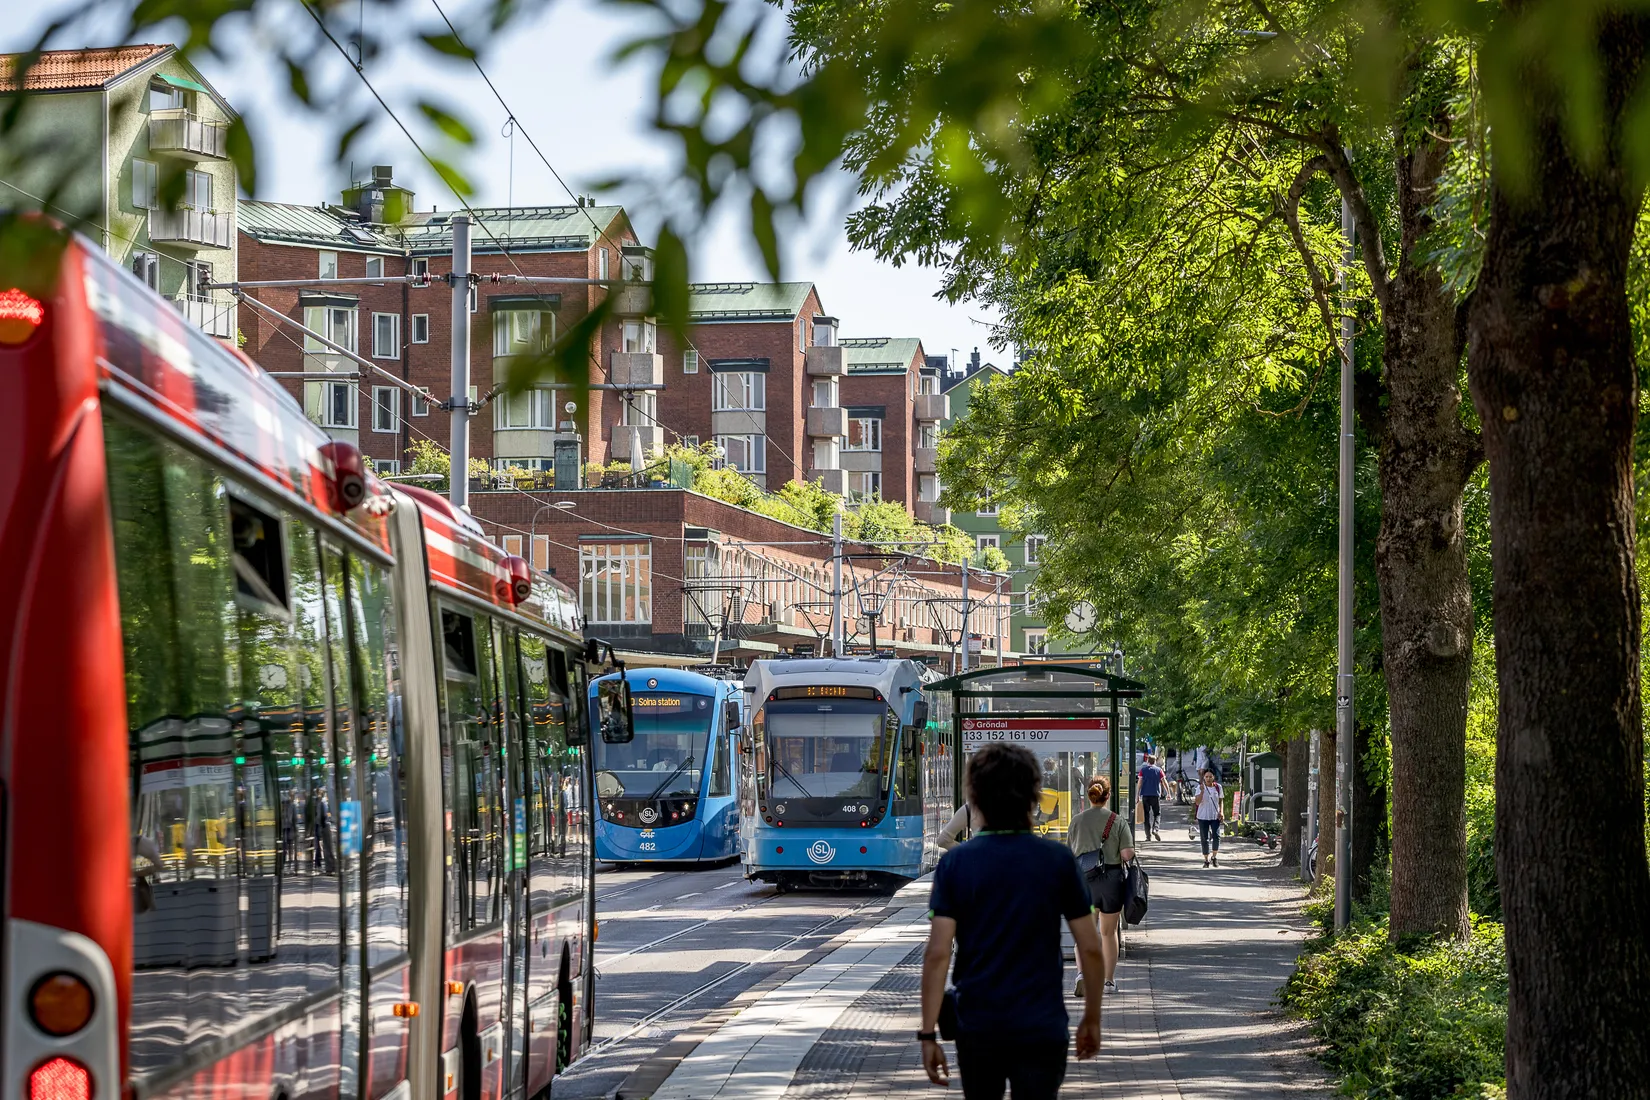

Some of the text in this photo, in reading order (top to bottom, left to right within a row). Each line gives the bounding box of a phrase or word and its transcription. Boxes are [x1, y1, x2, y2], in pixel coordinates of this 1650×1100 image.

[638, 697, 657, 706] Solna
[657, 697, 680, 706] station
[964, 731, 1049, 740] 133 152 161 907
[815, 844, 827, 854] SL
